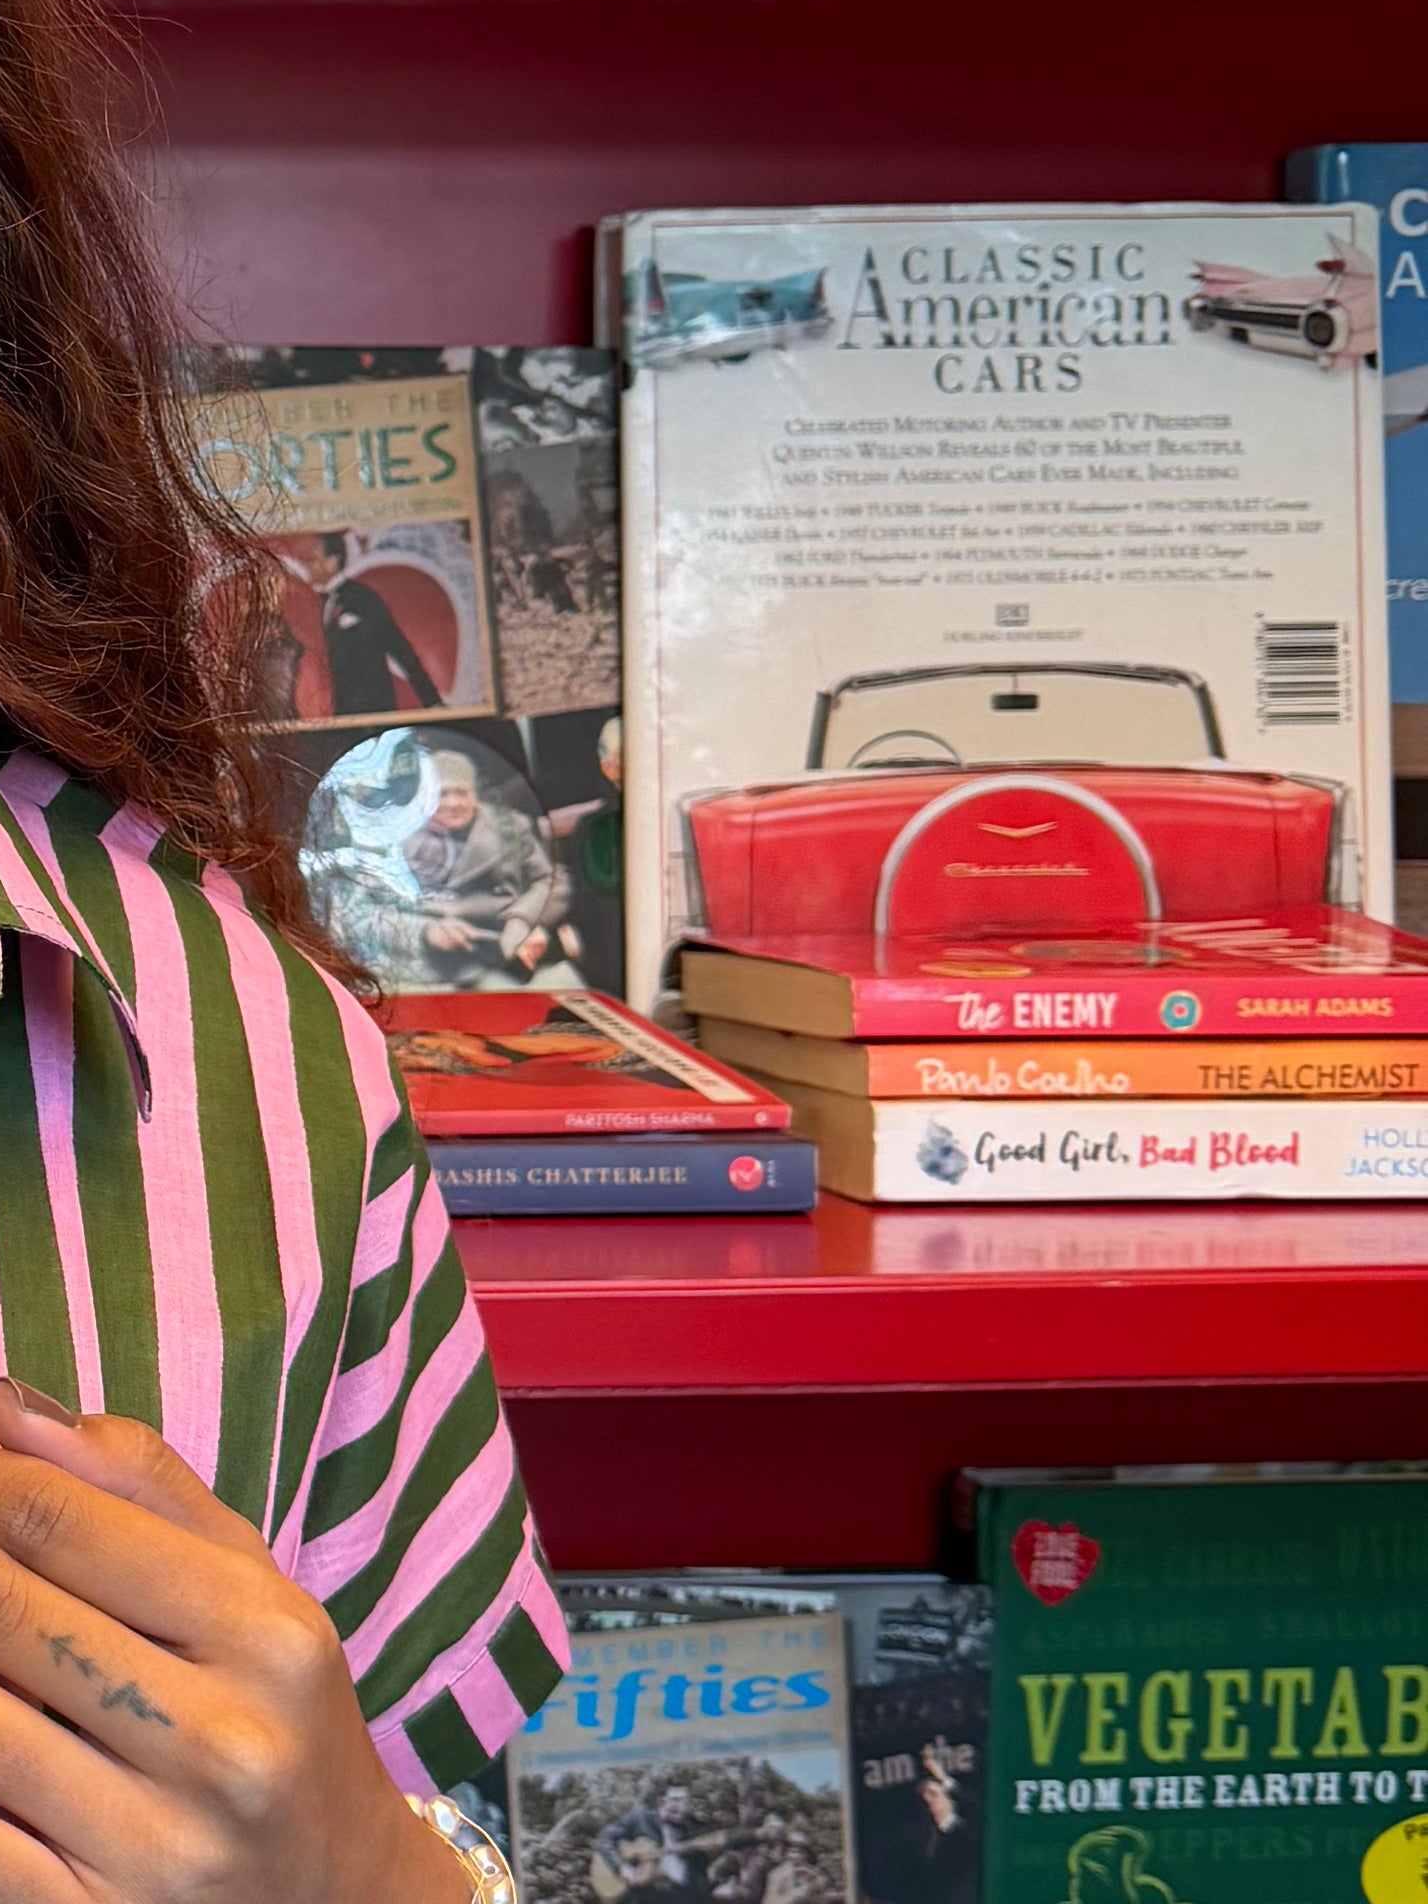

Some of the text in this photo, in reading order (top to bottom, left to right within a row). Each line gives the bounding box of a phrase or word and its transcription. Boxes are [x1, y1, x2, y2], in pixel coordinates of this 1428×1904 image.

[901, 241, 1147, 286] CLASSIC
[836, 246, 1177, 352] American
[934, 353, 1084, 395] CARS
[1013, 992, 1119, 1030] ENEMY
[1237, 996, 1393, 1018] SARAH ADAMS
[915, 1057, 1132, 1095] Paulo Coelho
[1197, 1063, 1420, 1090] THE ALCHEMIST
[564, 1111, 715, 1128] PARITOSH SHARMA
[974, 1128, 1299, 1173] Good Girl, Bad Blood
[526, 1165, 689, 1187] CHATTERJEE
[1017, 1664, 1428, 1767] VEGETAB
[1012, 1770, 1398, 1814] FROM THE EARTH TO
